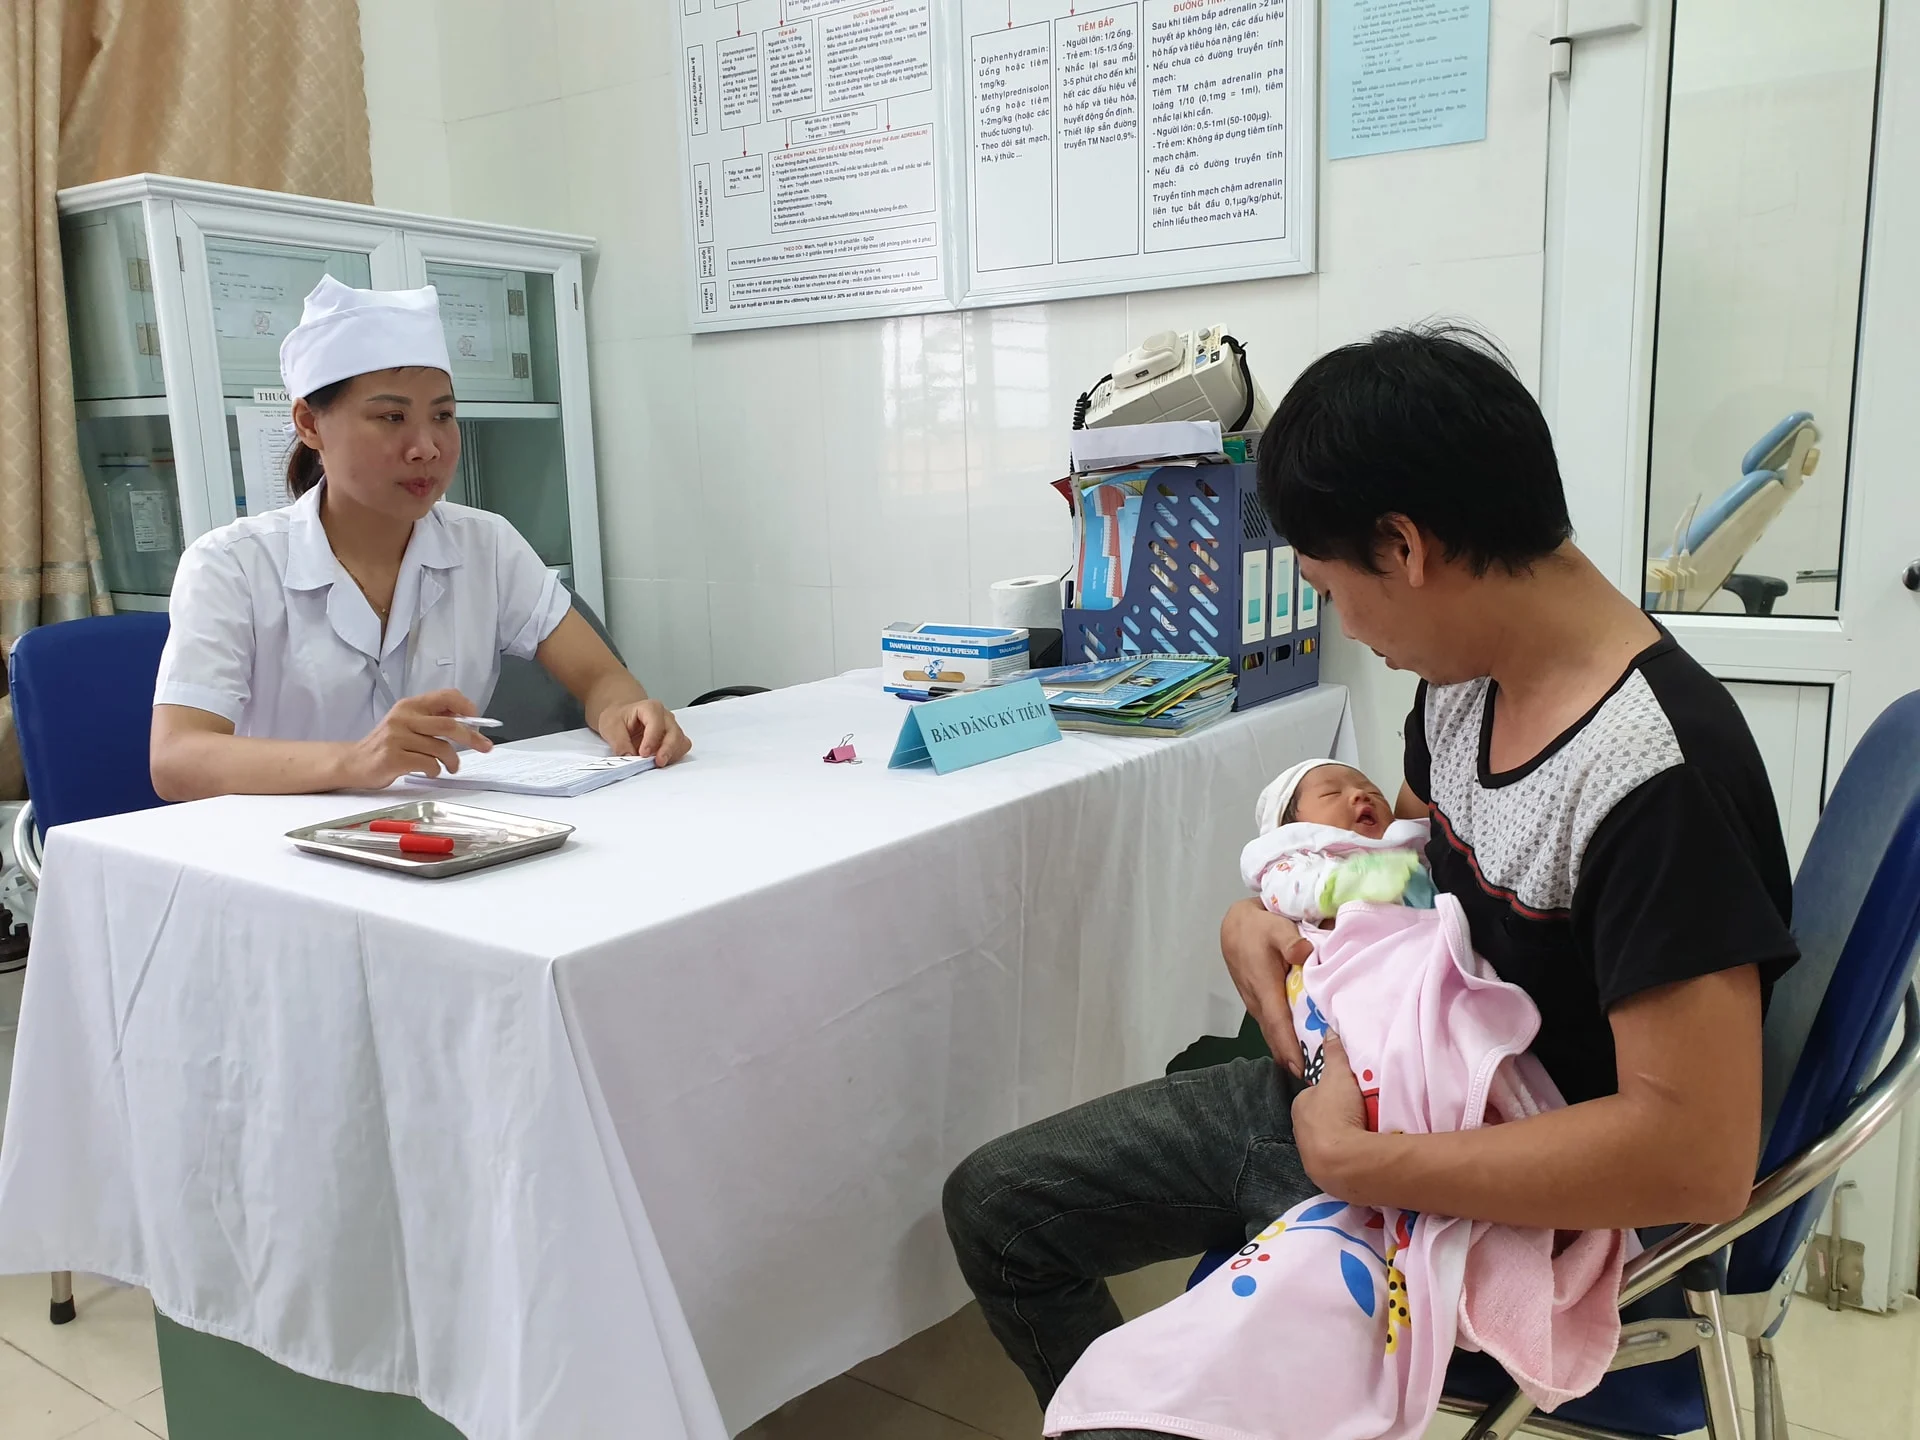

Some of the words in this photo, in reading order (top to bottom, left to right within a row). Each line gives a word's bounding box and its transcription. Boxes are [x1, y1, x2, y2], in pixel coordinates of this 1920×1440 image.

[1104, 30, 1115, 40] 1/2
[1176, 83, 1188, 93] TM
[1087, 136, 1098, 145] TM
[931, 719, 960, 743] BÀN
[961, 714, 998, 735] ĐĂNG
[1000, 706, 1016, 729] KÝ
[1017, 701, 1047, 722] TIÊM
